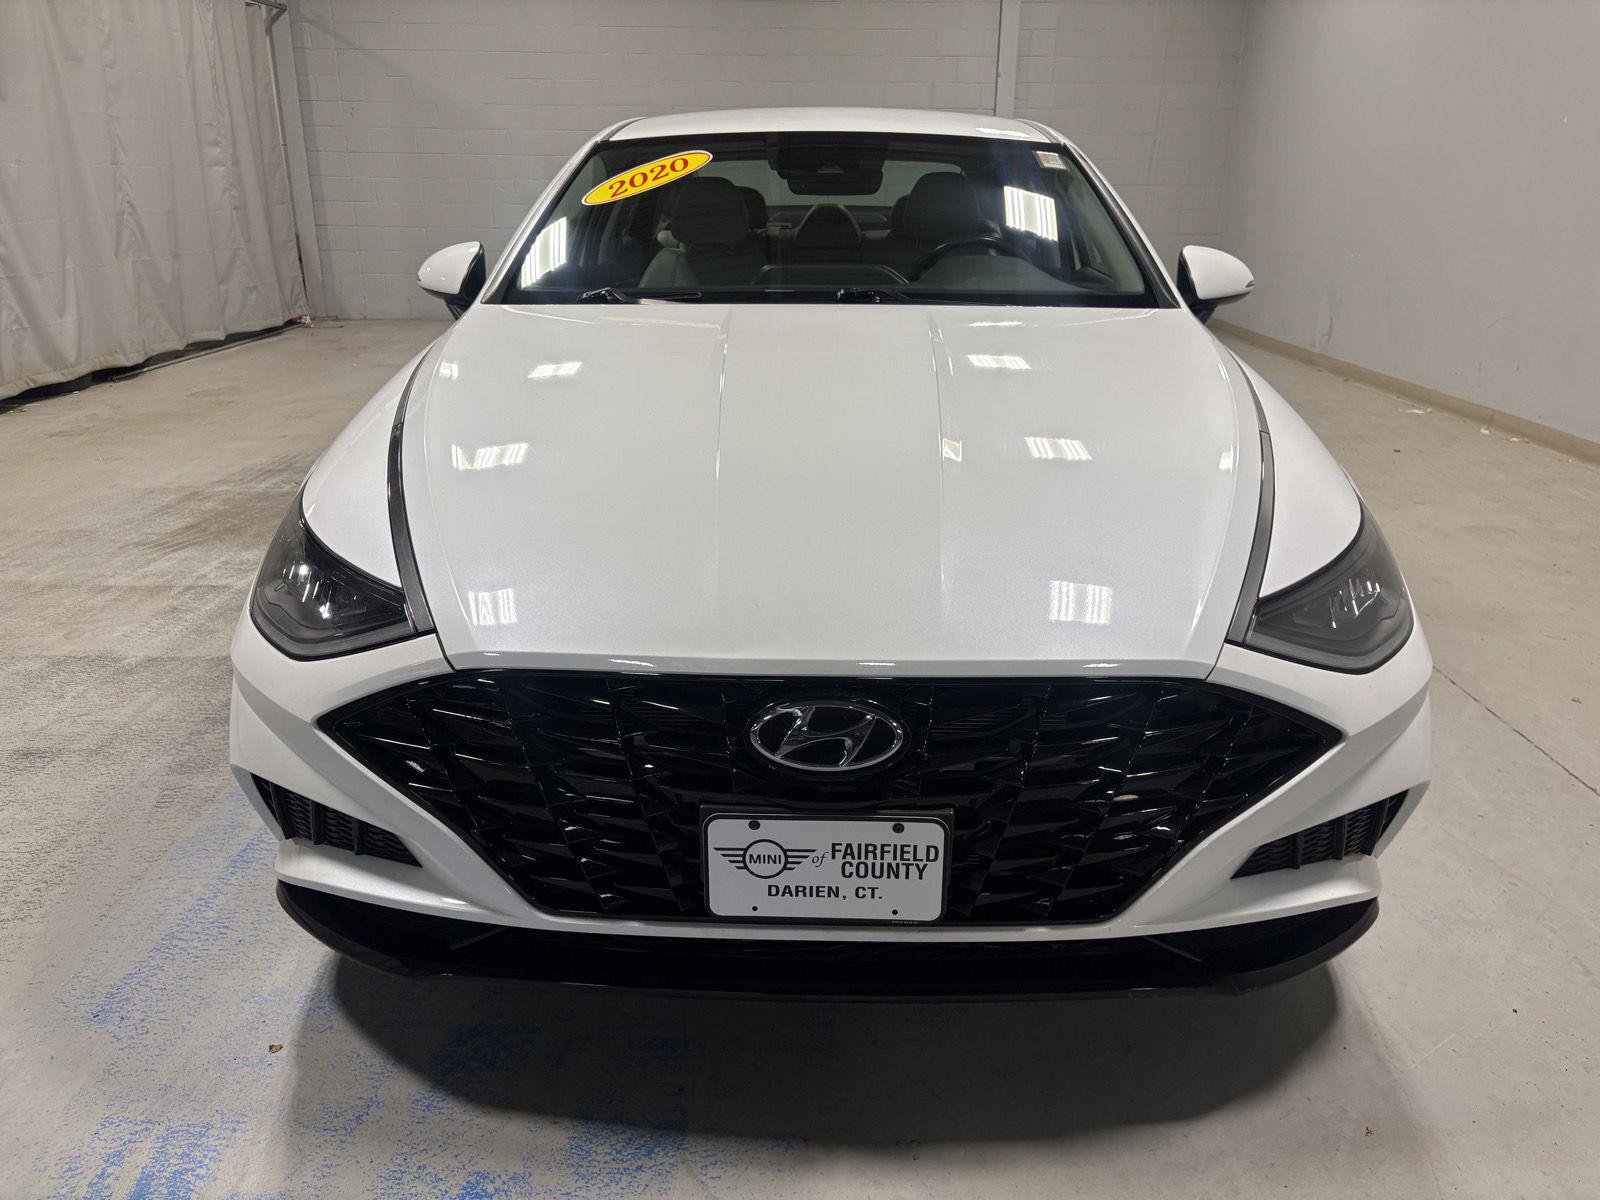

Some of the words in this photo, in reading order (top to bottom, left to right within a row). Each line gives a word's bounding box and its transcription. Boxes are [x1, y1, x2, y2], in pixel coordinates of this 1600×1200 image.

[608, 158, 689, 198] 2020
[749, 854, 782, 865] MINI
[811, 851, 829, 868] of
[831, 842, 940, 863] FAIRFIELD
[841, 861, 929, 880] COUNTY
[767, 884, 848, 901] DARIEN,
[854, 886, 883, 900] CT.
